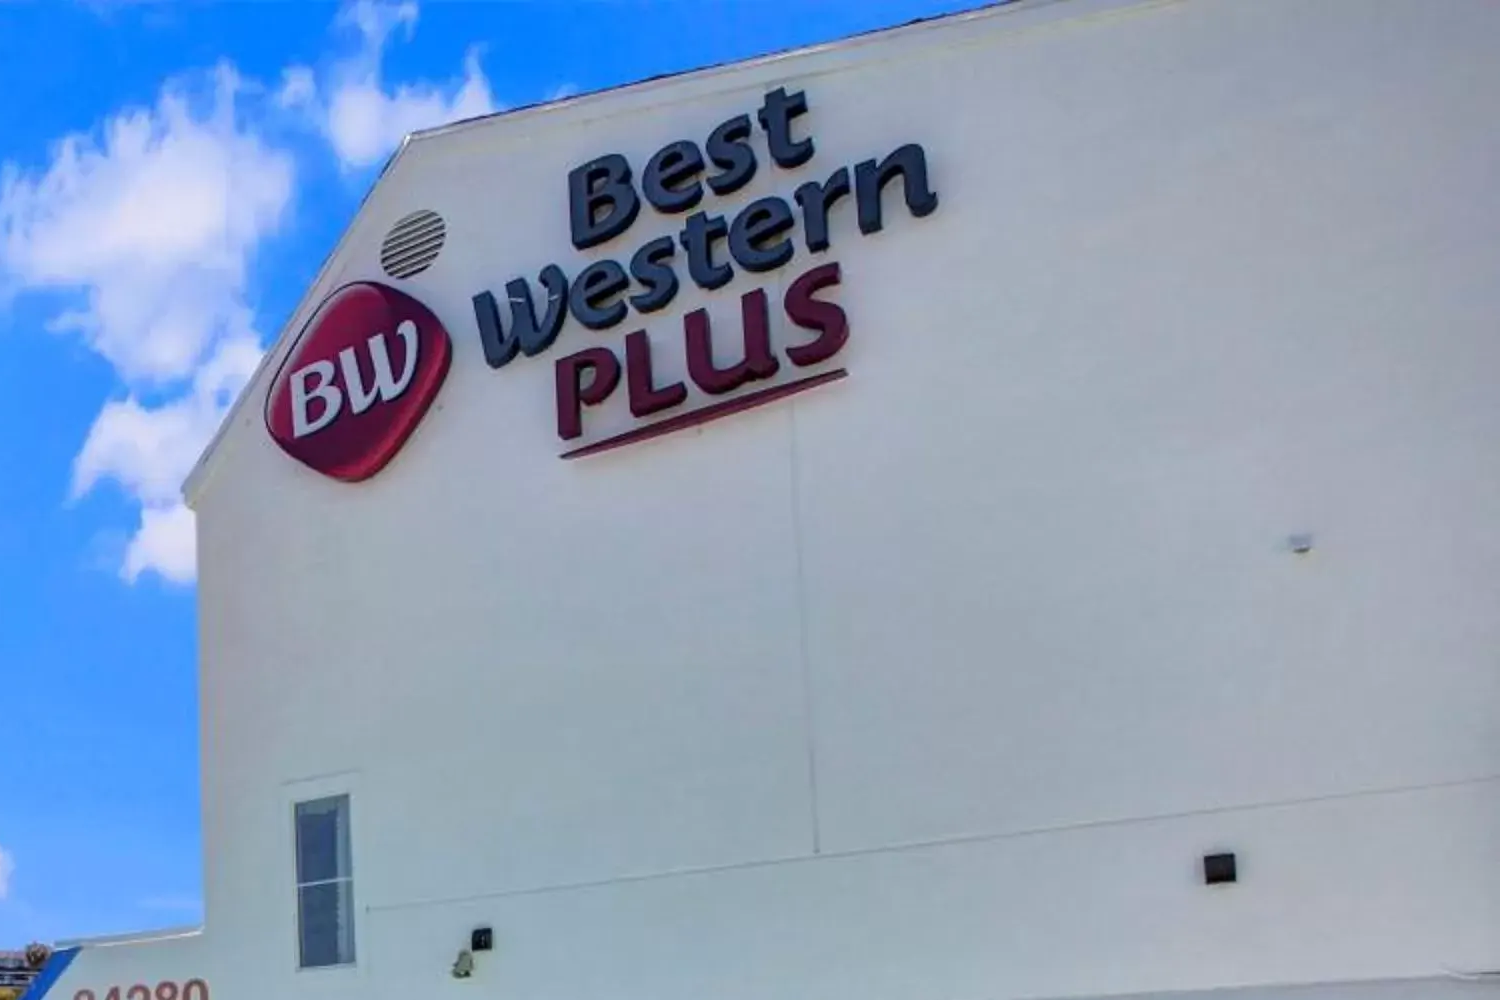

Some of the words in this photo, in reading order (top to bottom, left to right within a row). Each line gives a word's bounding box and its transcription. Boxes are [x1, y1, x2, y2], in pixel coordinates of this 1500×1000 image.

[567, 86, 817, 250] Best
[471, 142, 940, 370] Western
[289, 319, 419, 440] BW
[554, 262, 852, 441] PLUS
